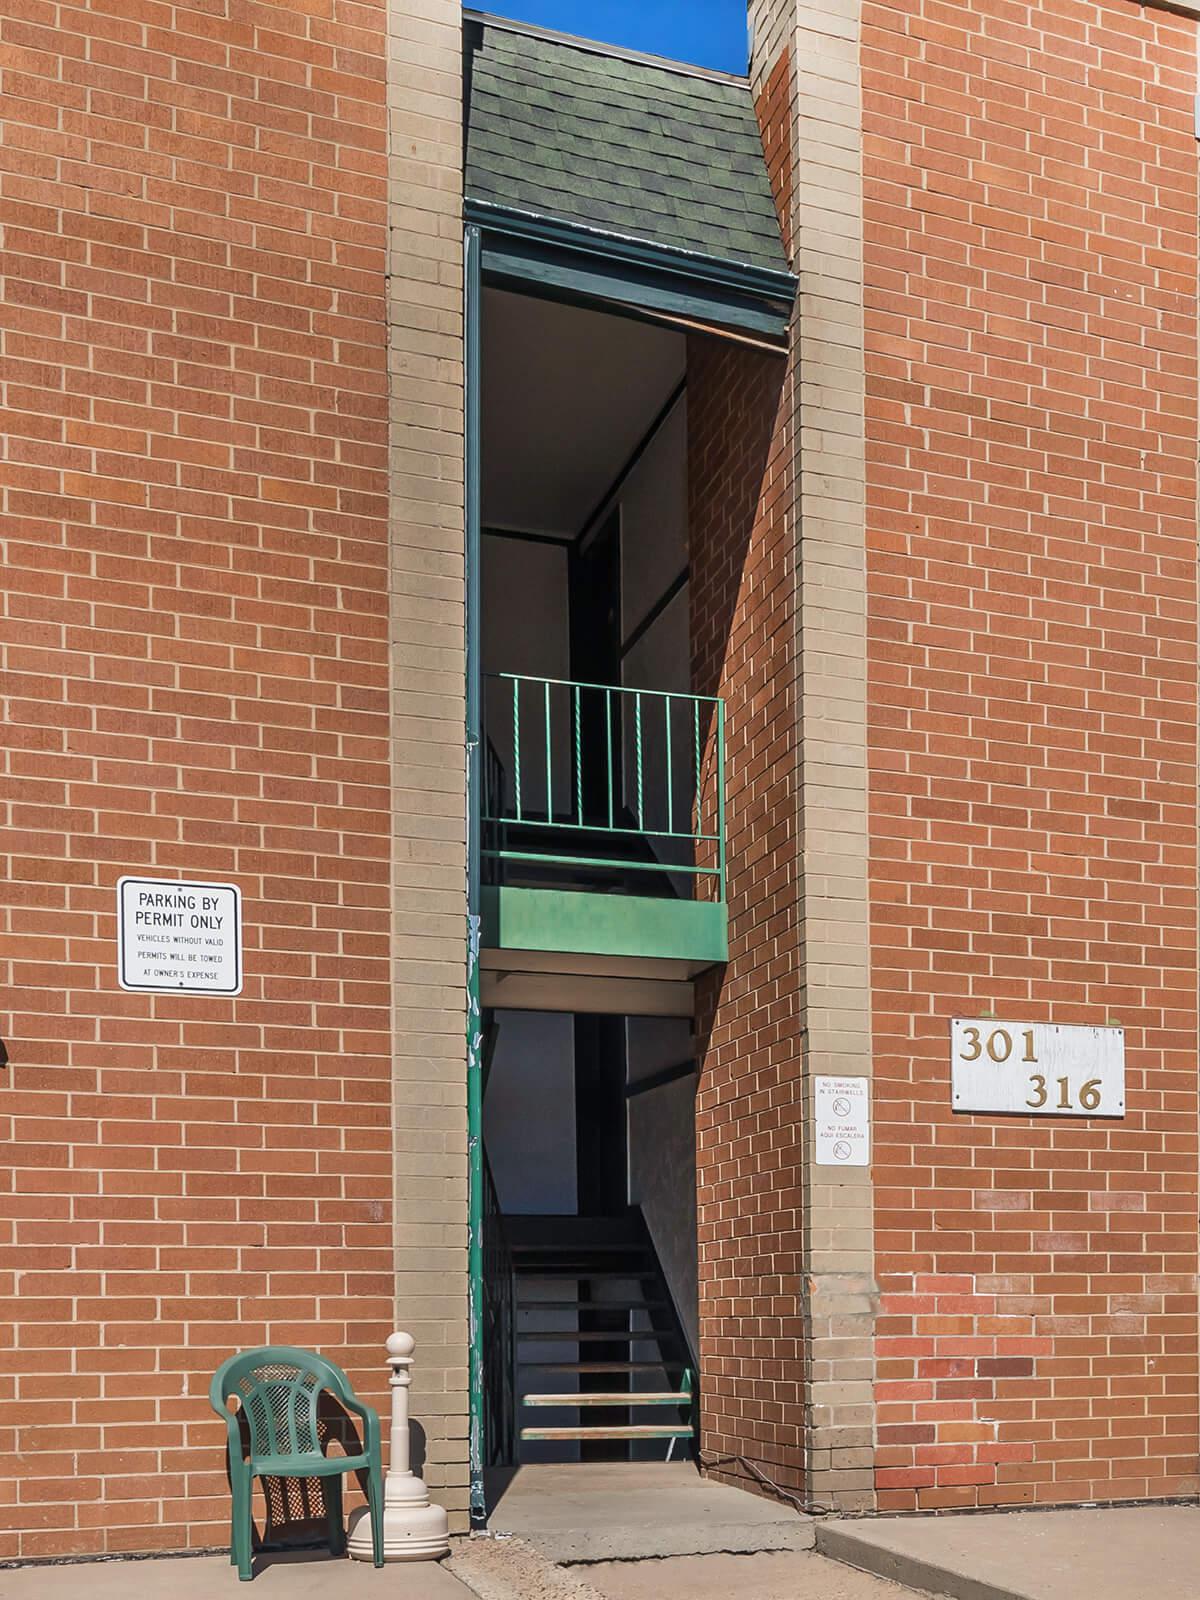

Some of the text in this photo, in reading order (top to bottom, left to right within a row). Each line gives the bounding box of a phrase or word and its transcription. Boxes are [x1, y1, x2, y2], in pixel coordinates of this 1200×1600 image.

[139, 893, 219, 911] PARKING BY
[135, 911, 223, 930] PERMIT ONLY
[137, 934, 224, 946] VEHICLES WITHOUT VALID
[137, 951, 223, 963] PERMITS WILL BE TOWED
[154, 969, 185, 978] OWNER'S
[187, 971, 219, 980] EXPENSE
[959, 1027, 1038, 1063] 301
[1026, 1074, 1102, 1110] 316
